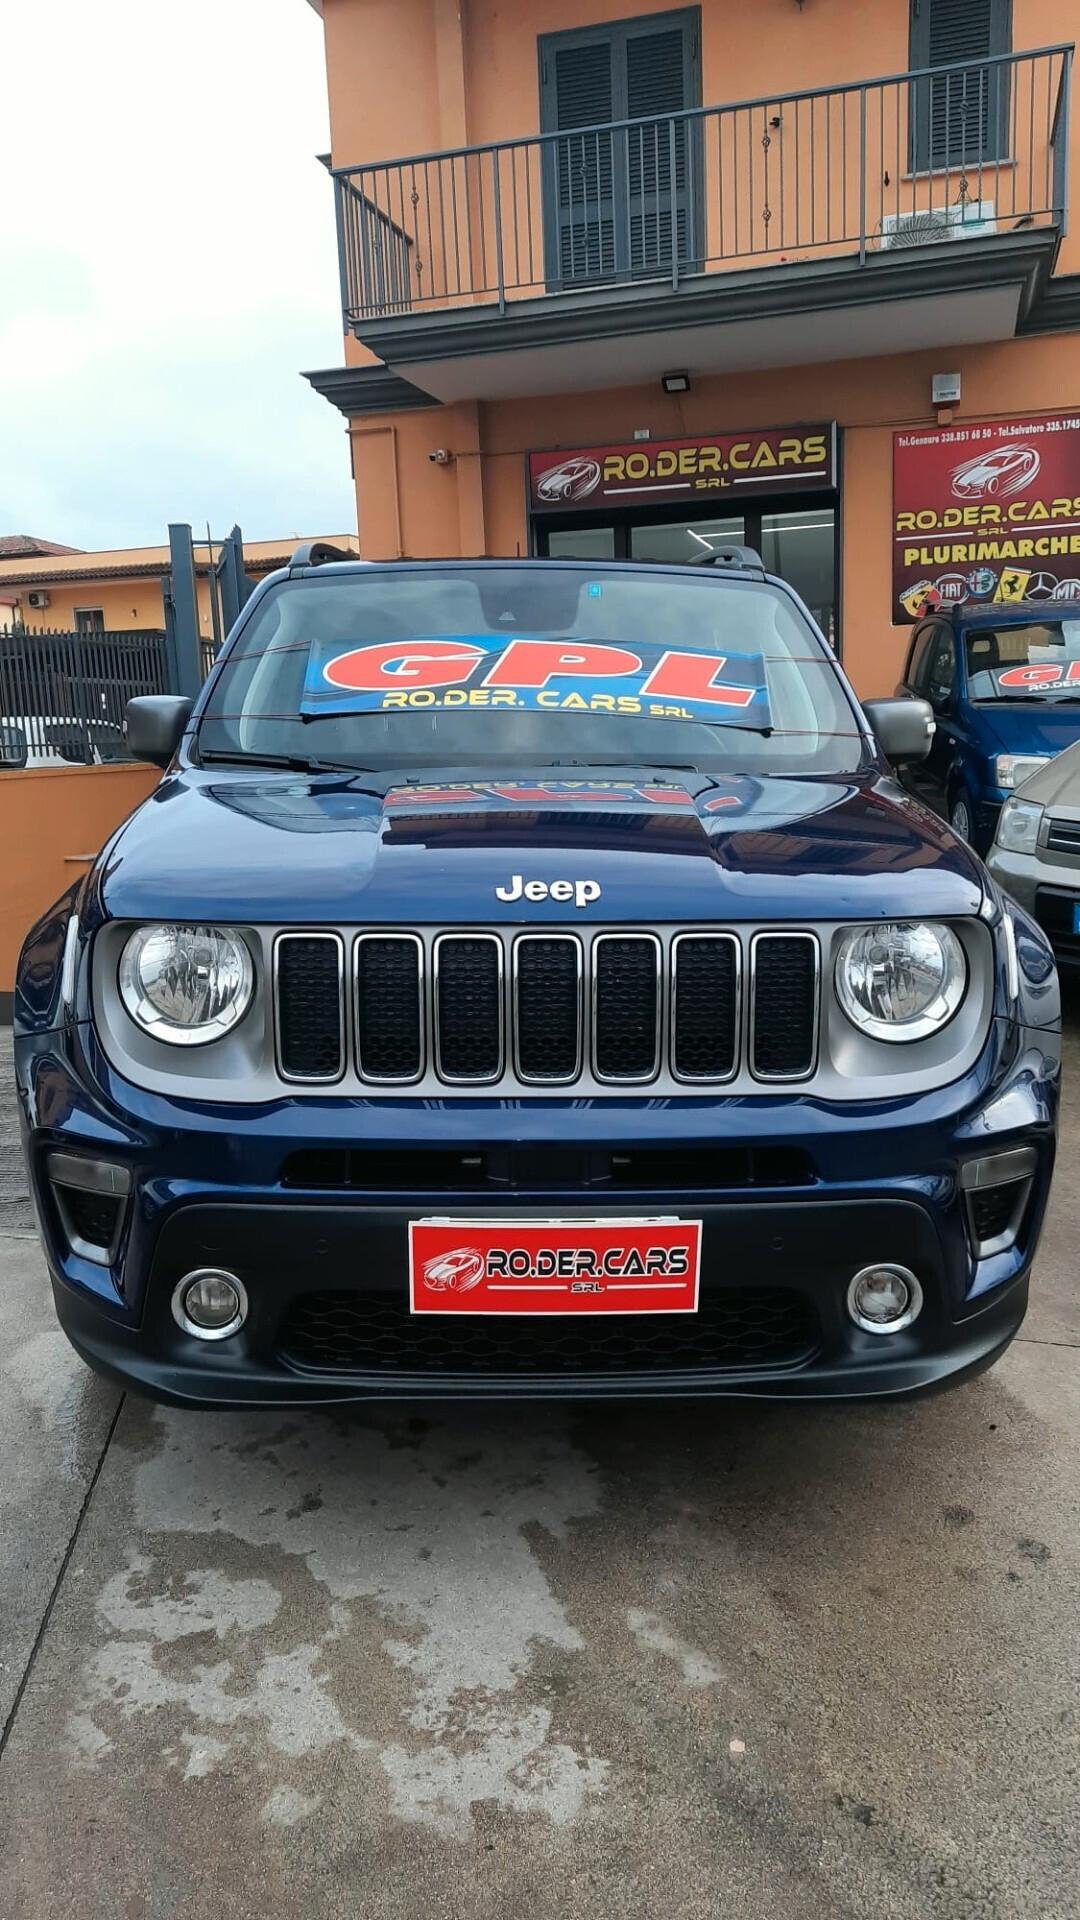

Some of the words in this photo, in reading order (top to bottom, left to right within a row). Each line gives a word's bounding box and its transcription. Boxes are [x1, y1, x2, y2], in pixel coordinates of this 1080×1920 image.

[982, 428, 992, 439] 50
[998, 424, 1045, 437] Tel.Salvatore
[603, 435, 826, 482] RO.DER.CARS
[695, 477, 731, 489] SRL
[976, 527, 1009, 536] SRL
[903, 535, 1080, 567] PLURIMARCHE
[940, 582, 962, 599] FIAT
[322, 639, 757, 708] GPL
[998, 660, 1080, 687] G
[382, 689, 525, 708] RO.DER.
[536, 691, 641, 713] CARS
[649, 704, 694, 719] SRL
[495, 875, 601, 907] Jeep
[486, 1246, 690, 1278] RO.DER.CARS
[570, 1281, 606, 1293] SRL
